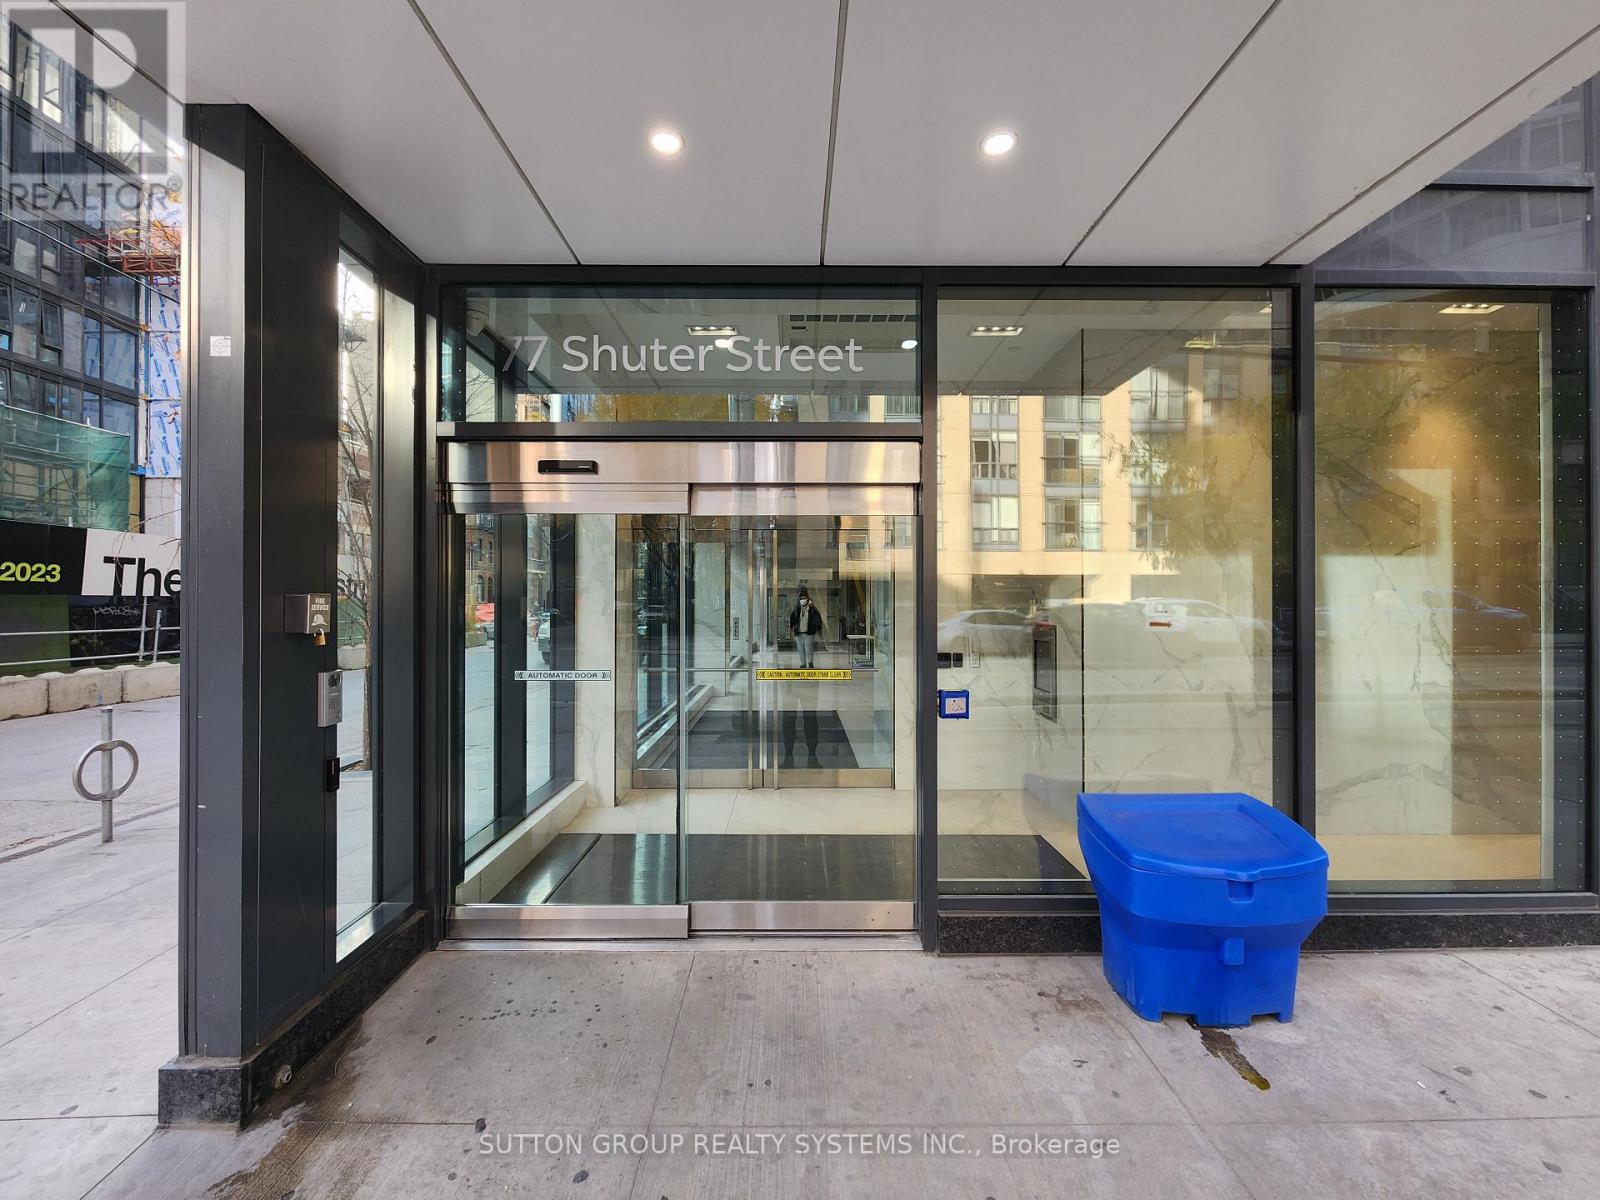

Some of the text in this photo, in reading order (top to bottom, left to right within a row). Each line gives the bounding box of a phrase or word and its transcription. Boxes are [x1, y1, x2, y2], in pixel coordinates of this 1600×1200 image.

[503, 335, 864, 372] 77 Shuter Street
[0, 561, 61, 583] 2023
[785, 671, 806, 679] AUTOMATIC
